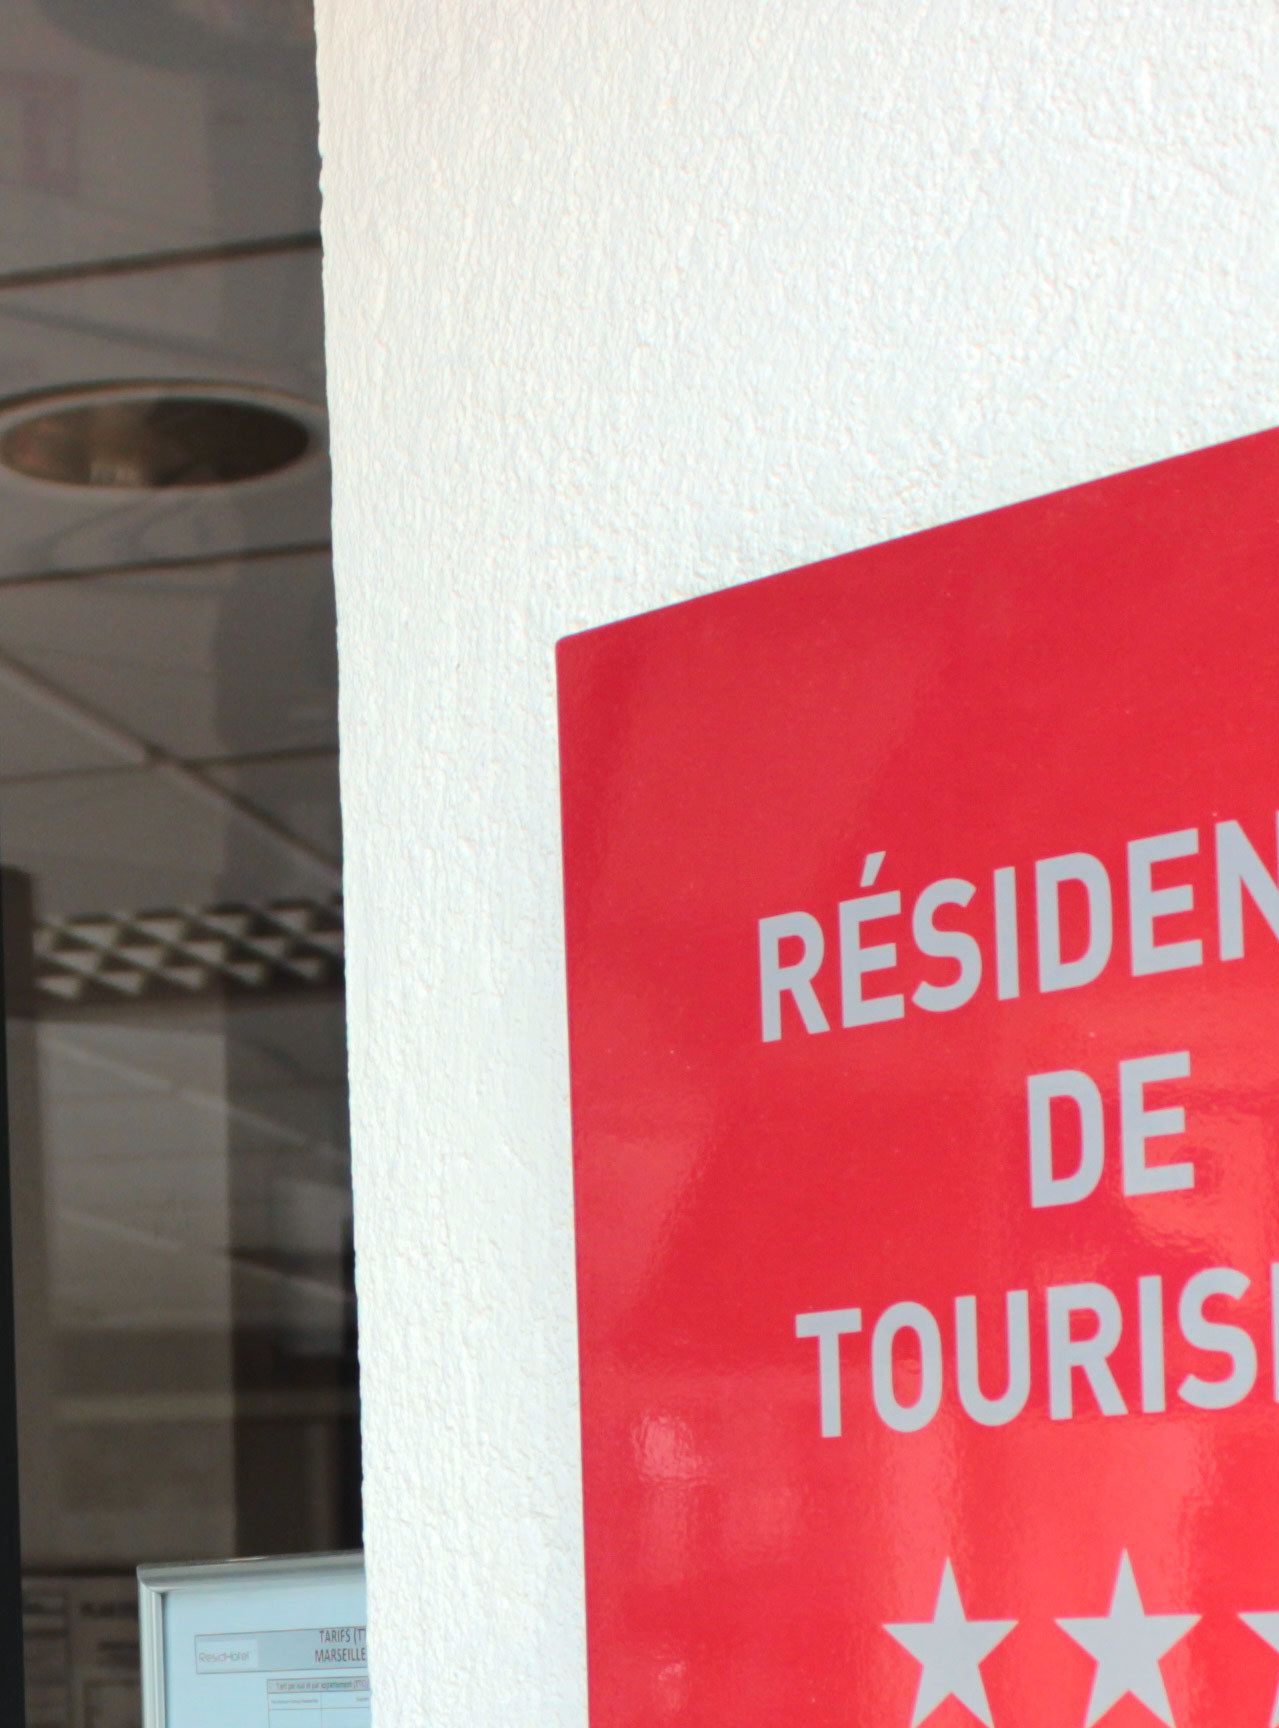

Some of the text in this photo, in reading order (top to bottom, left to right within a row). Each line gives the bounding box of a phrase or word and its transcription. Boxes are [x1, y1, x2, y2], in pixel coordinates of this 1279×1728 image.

[1025, 1049, 1197, 1209] DE
[318, 1627, 351, 1644] TARIFS
[314, 1647, 367, 1663] MARSEILLE
